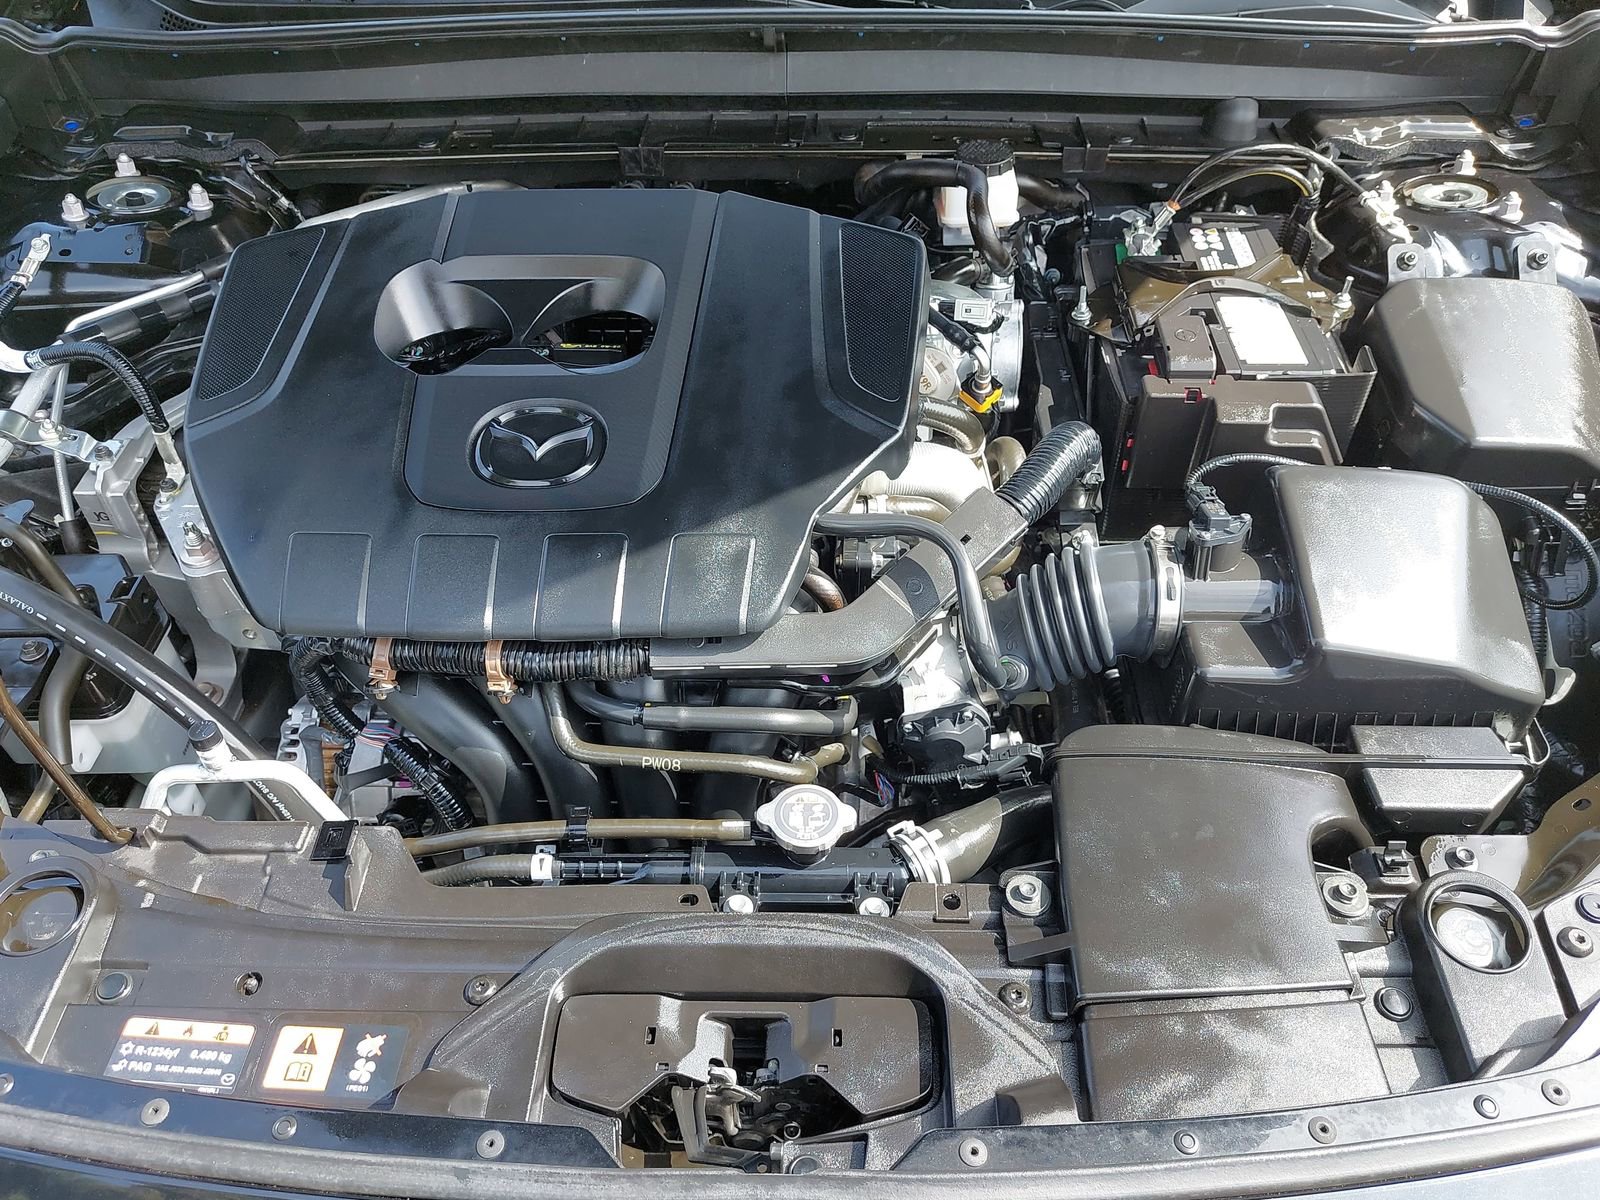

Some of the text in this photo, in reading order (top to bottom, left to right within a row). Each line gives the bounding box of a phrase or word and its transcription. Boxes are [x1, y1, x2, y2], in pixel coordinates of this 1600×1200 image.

[642, 757, 681, 771] PW08
[217, 1051, 233, 1065] kg
[128, 1060, 152, 1073] PAG
